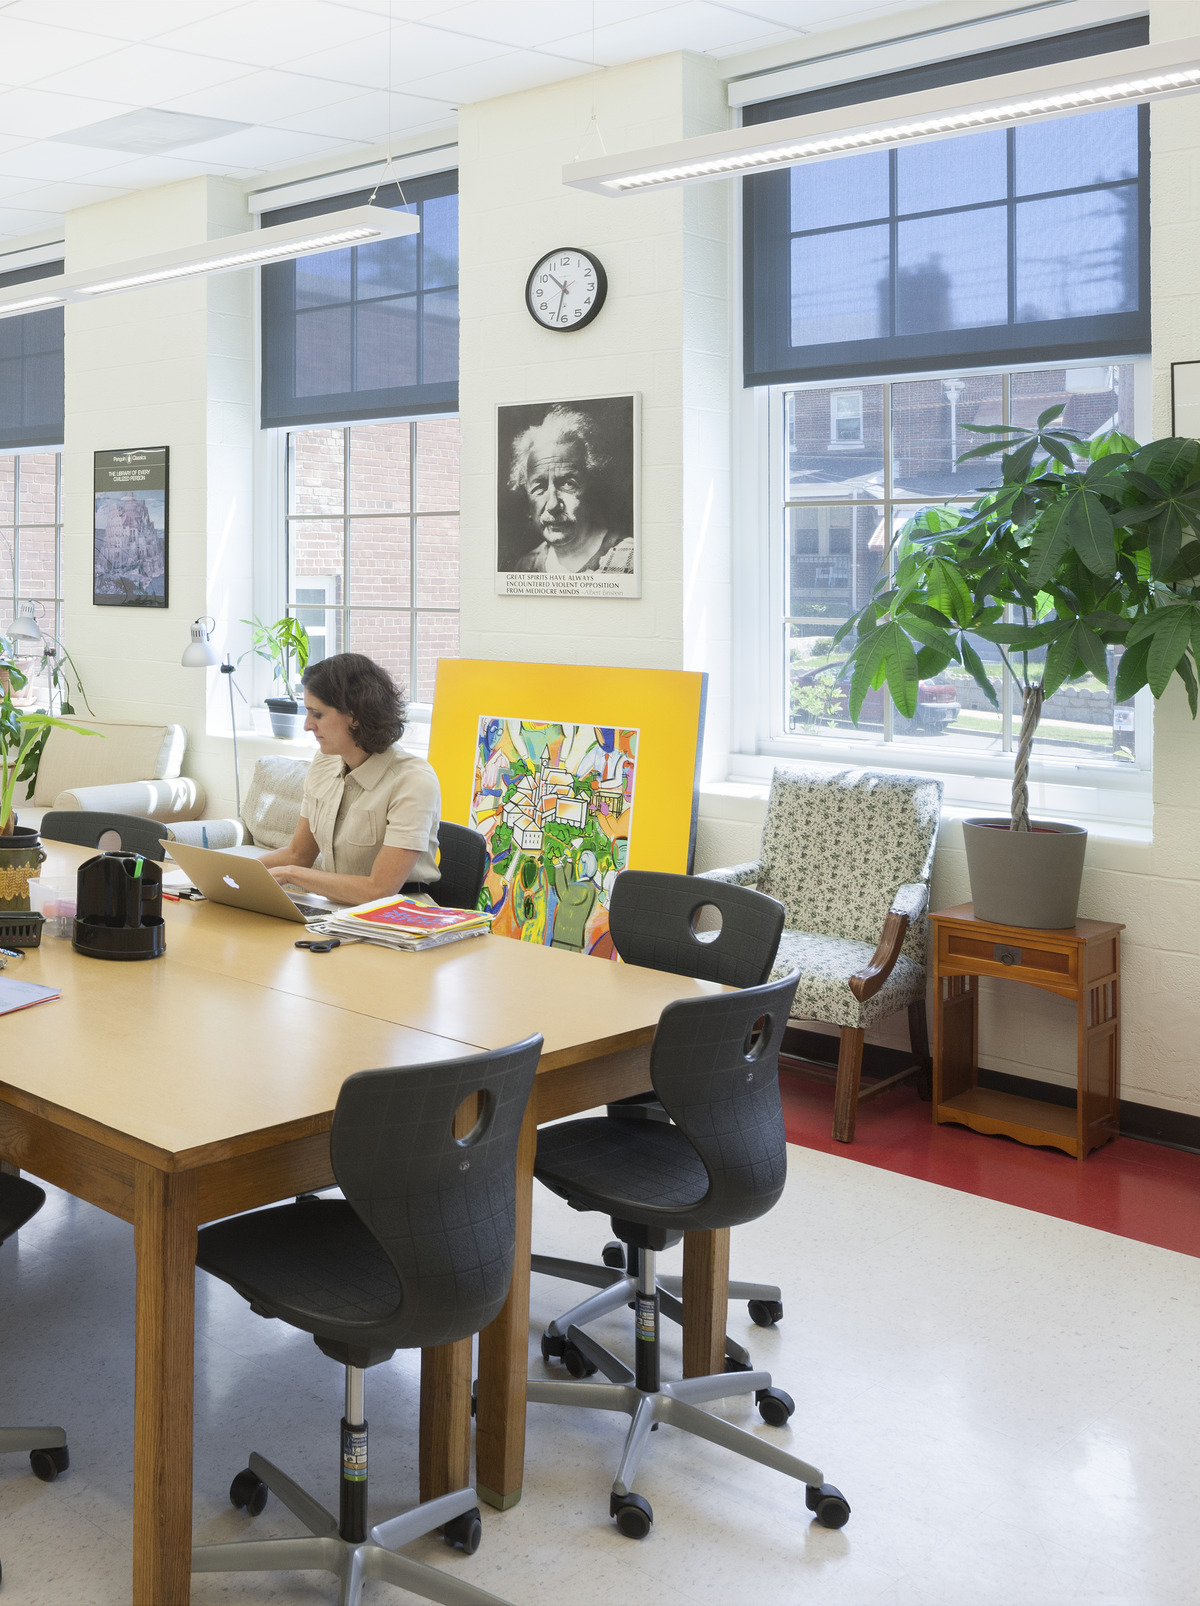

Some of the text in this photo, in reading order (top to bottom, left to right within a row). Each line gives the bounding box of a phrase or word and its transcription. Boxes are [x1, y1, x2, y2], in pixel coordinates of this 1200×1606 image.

[560, 256, 570, 266] 12
[577, 259, 581, 268] 1
[549, 262, 556, 271] 11
[583, 268, 592, 277] 2
[540, 274, 549, 283] 10
[586, 282, 595, 292] 3
[536, 289, 544, 297] 9
[583, 297, 592, 305] 4
[540, 302, 548, 310] 8
[549, 312, 556, 320] 7
[574, 308, 582, 317] 5
[560, 315, 568, 323] 6
